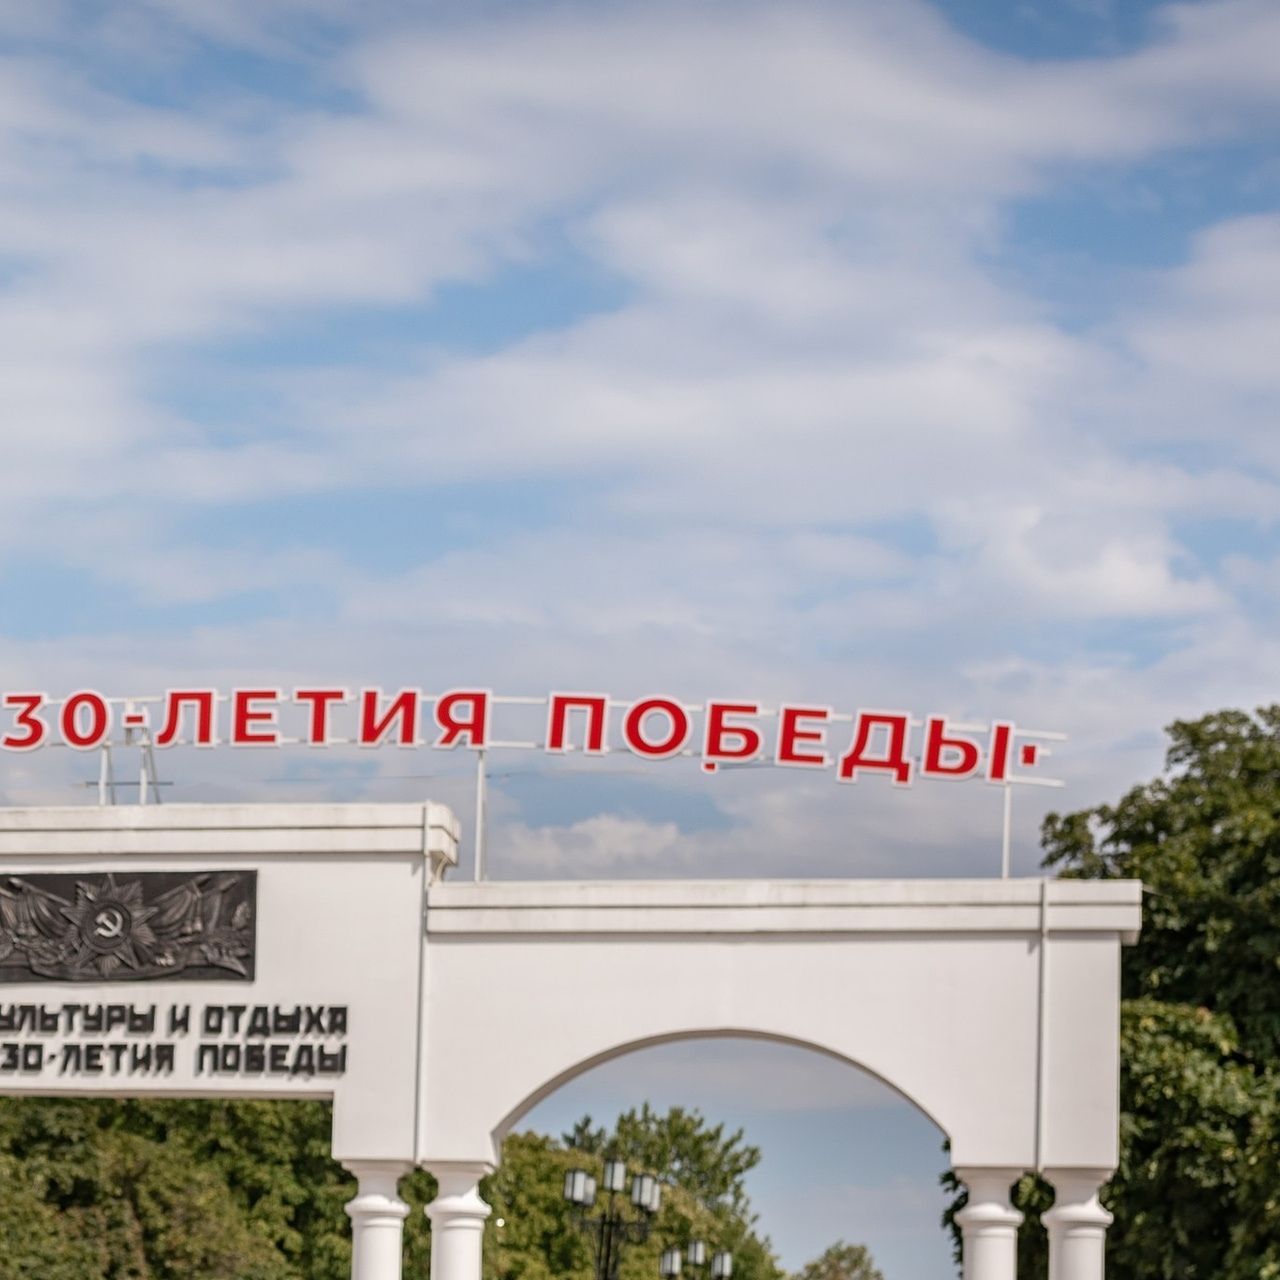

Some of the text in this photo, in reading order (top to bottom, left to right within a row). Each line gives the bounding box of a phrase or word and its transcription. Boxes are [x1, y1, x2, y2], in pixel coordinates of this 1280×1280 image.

[1, 688, 490, 750] 30-ЛЕТИЯ
[169, 1004, 191, 1035] И
[203, 1005, 349, 1038] ОТДЫХА
[0, 1042, 175, 1073] 30-ЛЕТИЯ
[197, 1043, 348, 1077] ПОБЕДЫ
